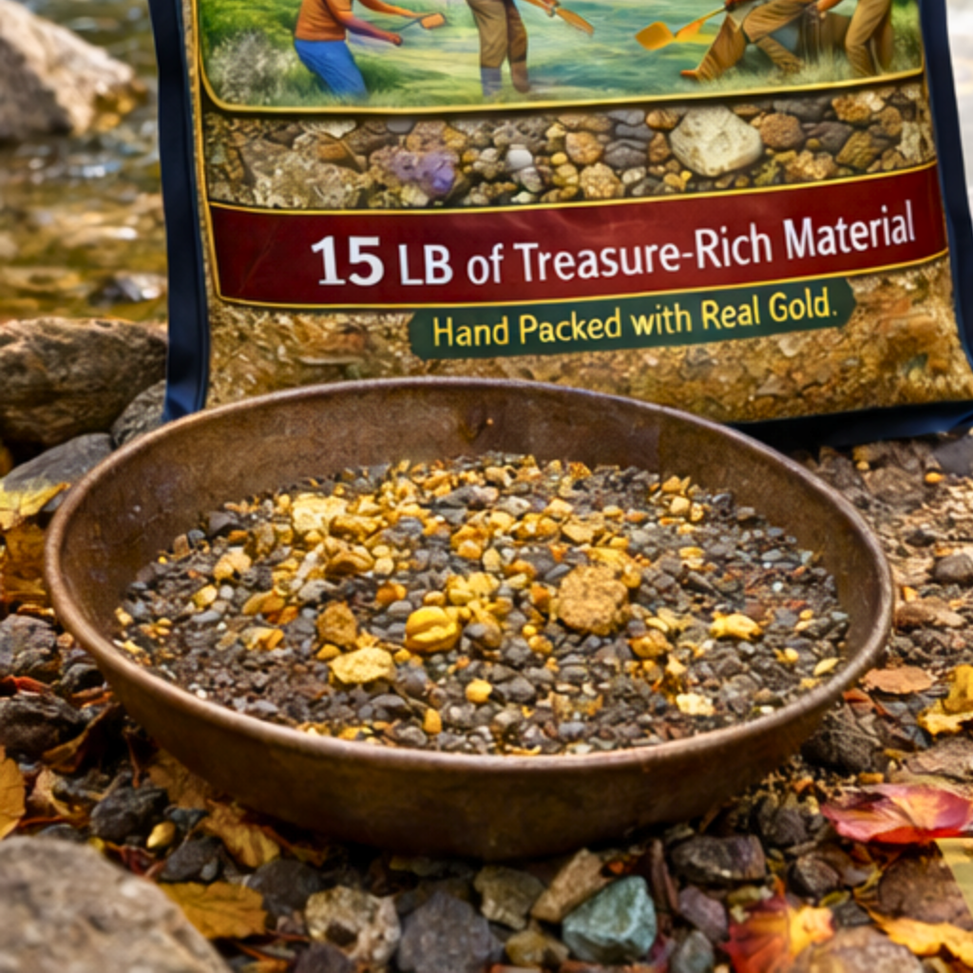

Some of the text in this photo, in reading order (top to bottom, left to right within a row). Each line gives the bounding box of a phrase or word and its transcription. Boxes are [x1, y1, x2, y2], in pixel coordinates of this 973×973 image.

[310, 201, 915, 287] 15 LB of Treasure-Rich Material
[433, 289, 838, 348] Hand Packed with Real Gold.
